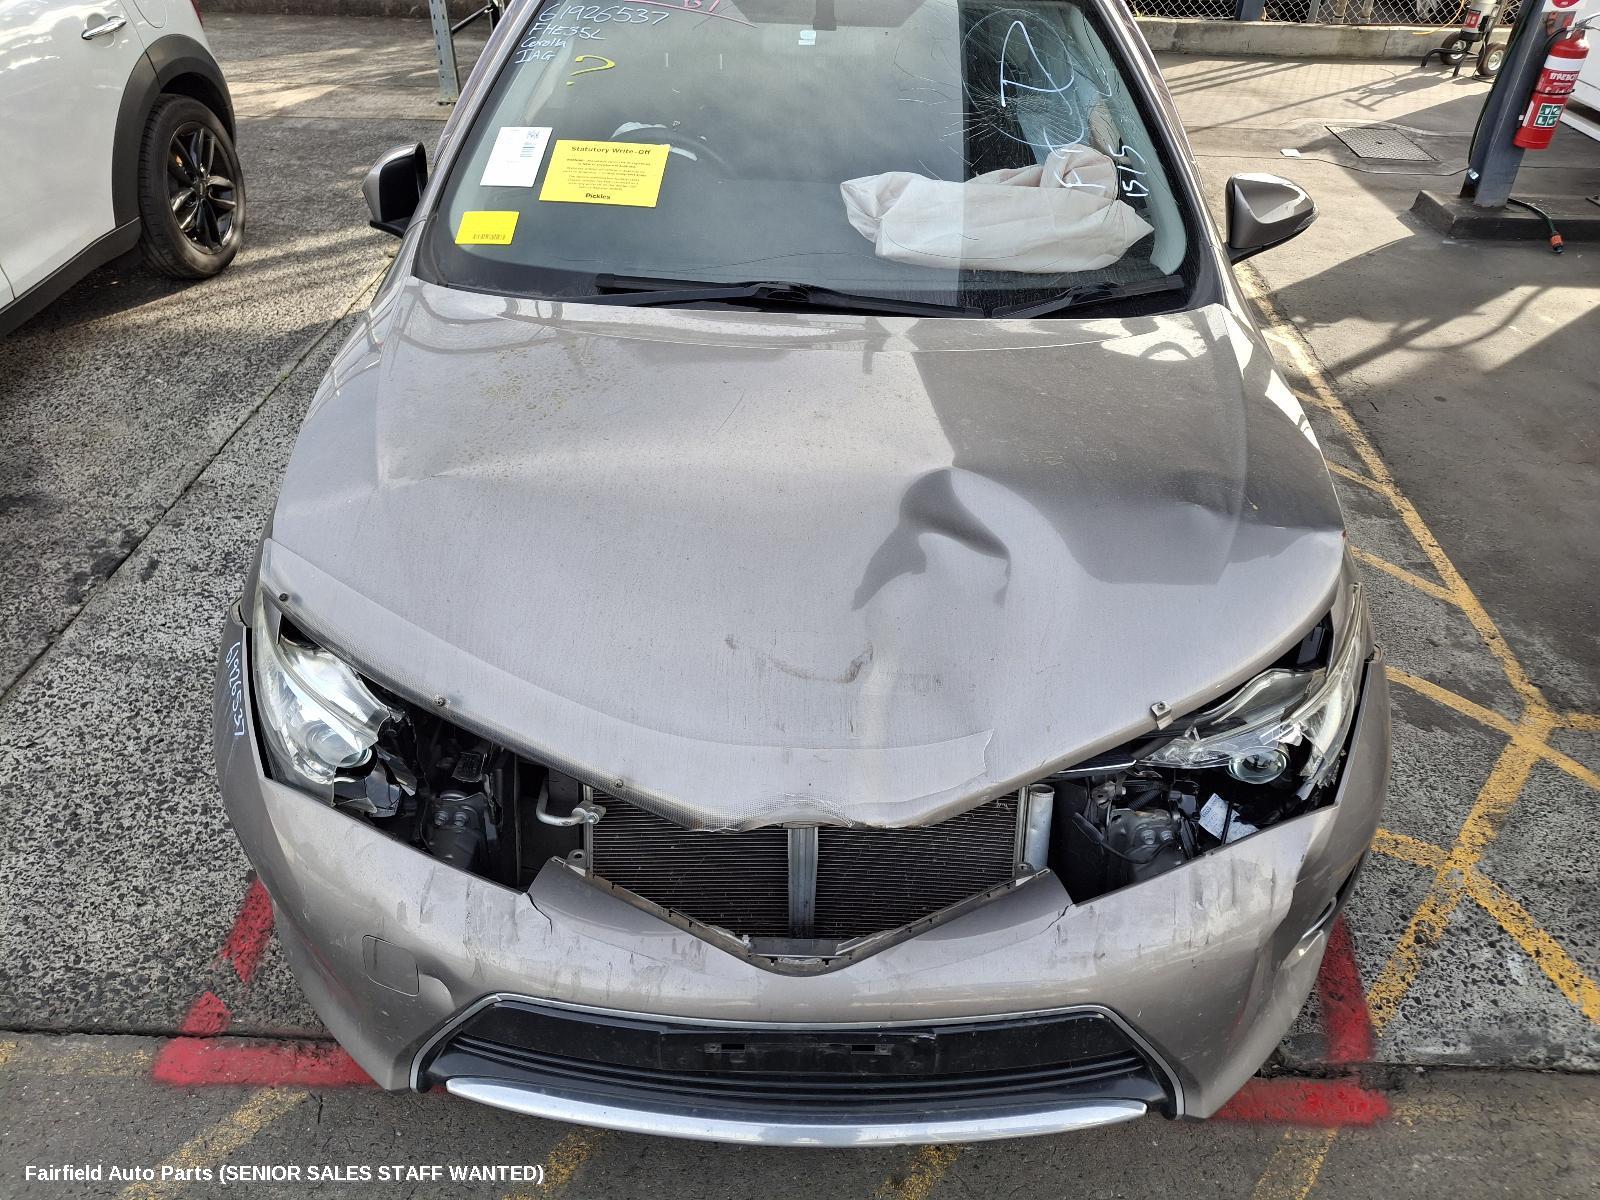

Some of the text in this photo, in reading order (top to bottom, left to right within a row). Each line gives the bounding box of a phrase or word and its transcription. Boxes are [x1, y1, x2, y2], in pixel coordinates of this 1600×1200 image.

[538, 3, 670, 25] 61926537
[571, 145, 610, 154] Statutory
[585, 192, 611, 200] Pickles
[225, 641, 245, 736] 61926537
